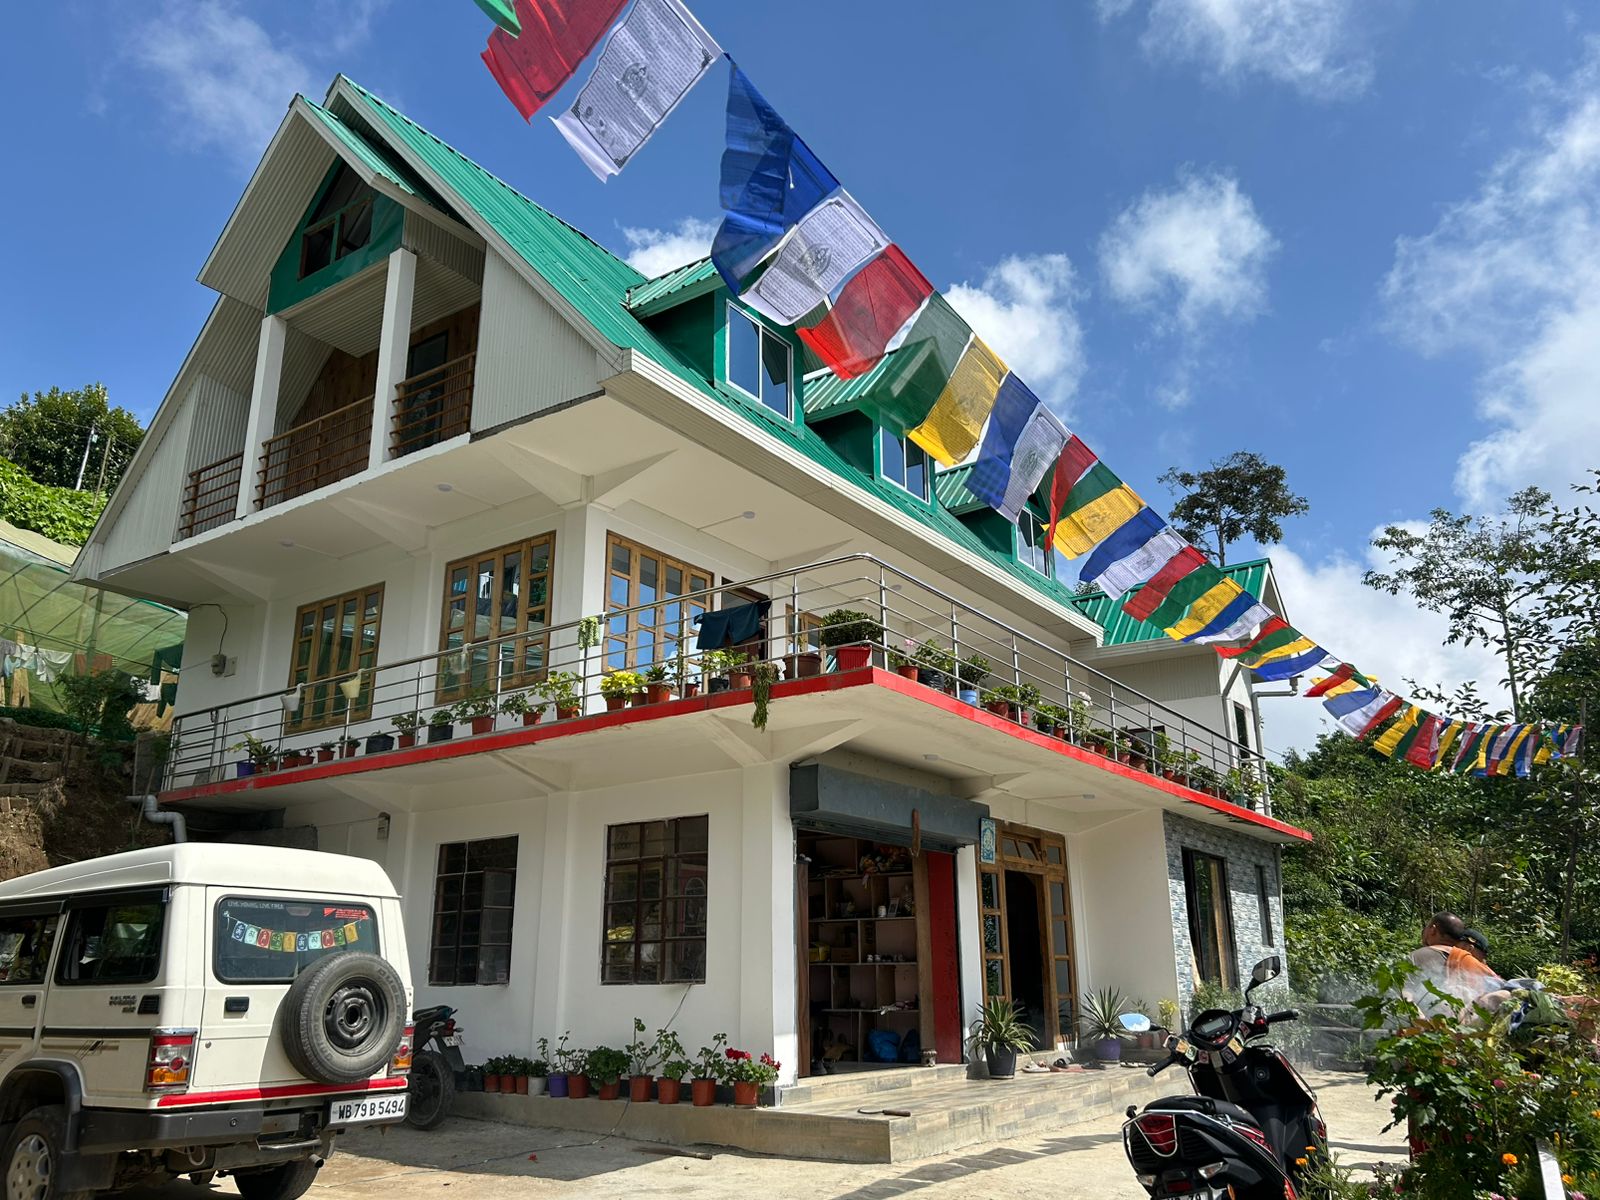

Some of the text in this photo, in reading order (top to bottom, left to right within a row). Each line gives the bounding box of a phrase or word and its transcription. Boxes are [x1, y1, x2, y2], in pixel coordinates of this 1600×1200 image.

[338, 1099, 404, 1119] WB 79 B 5494
